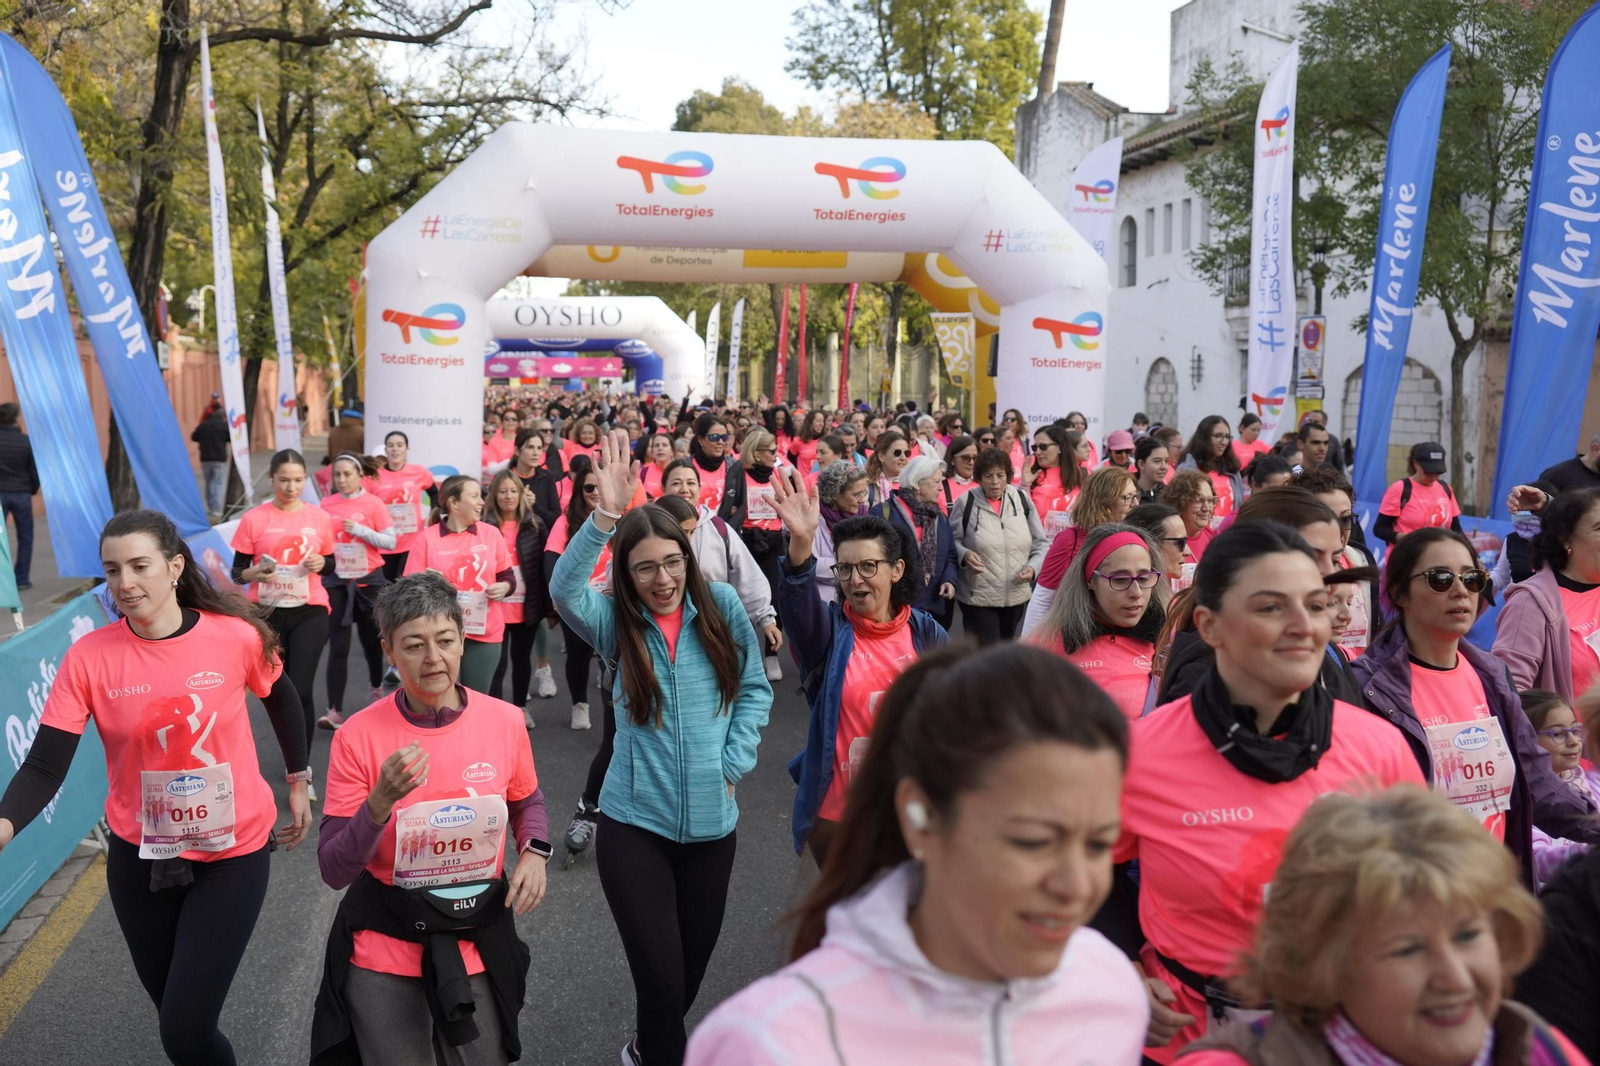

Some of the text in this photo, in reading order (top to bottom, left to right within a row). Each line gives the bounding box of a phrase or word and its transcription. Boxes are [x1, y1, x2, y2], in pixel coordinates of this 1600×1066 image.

[616, 203, 714, 220] TotalEnergies
[813, 208, 906, 223] TotalEnergies
[650, 255, 713, 265] de Deportes
[1373, 183, 1417, 350] Marlene
[515, 304, 622, 327] OYSHO
[380, 353, 465, 368] TotalEnergies
[1030, 357, 1102, 372] TotalEnergies
[109, 683, 151, 699] OYSHO
[1463, 760, 1495, 780] 016
[169, 782, 205, 792] ASTURIANA
[1475, 784, 1488, 793] 332
[171, 804, 208, 823] 016
[433, 813, 474, 825] ASTURIANA
[1182, 806, 1254, 827] OYSHO
[182, 825, 200, 835] 1115
[405, 819, 428, 828] SUMA
[151, 845, 182, 855] OYSHO
[433, 837, 473, 856] 016
[441, 858, 461, 867] 3113
[468, 861, 487, 870] SEVILLA
[404, 878, 439, 887] OYSHO
